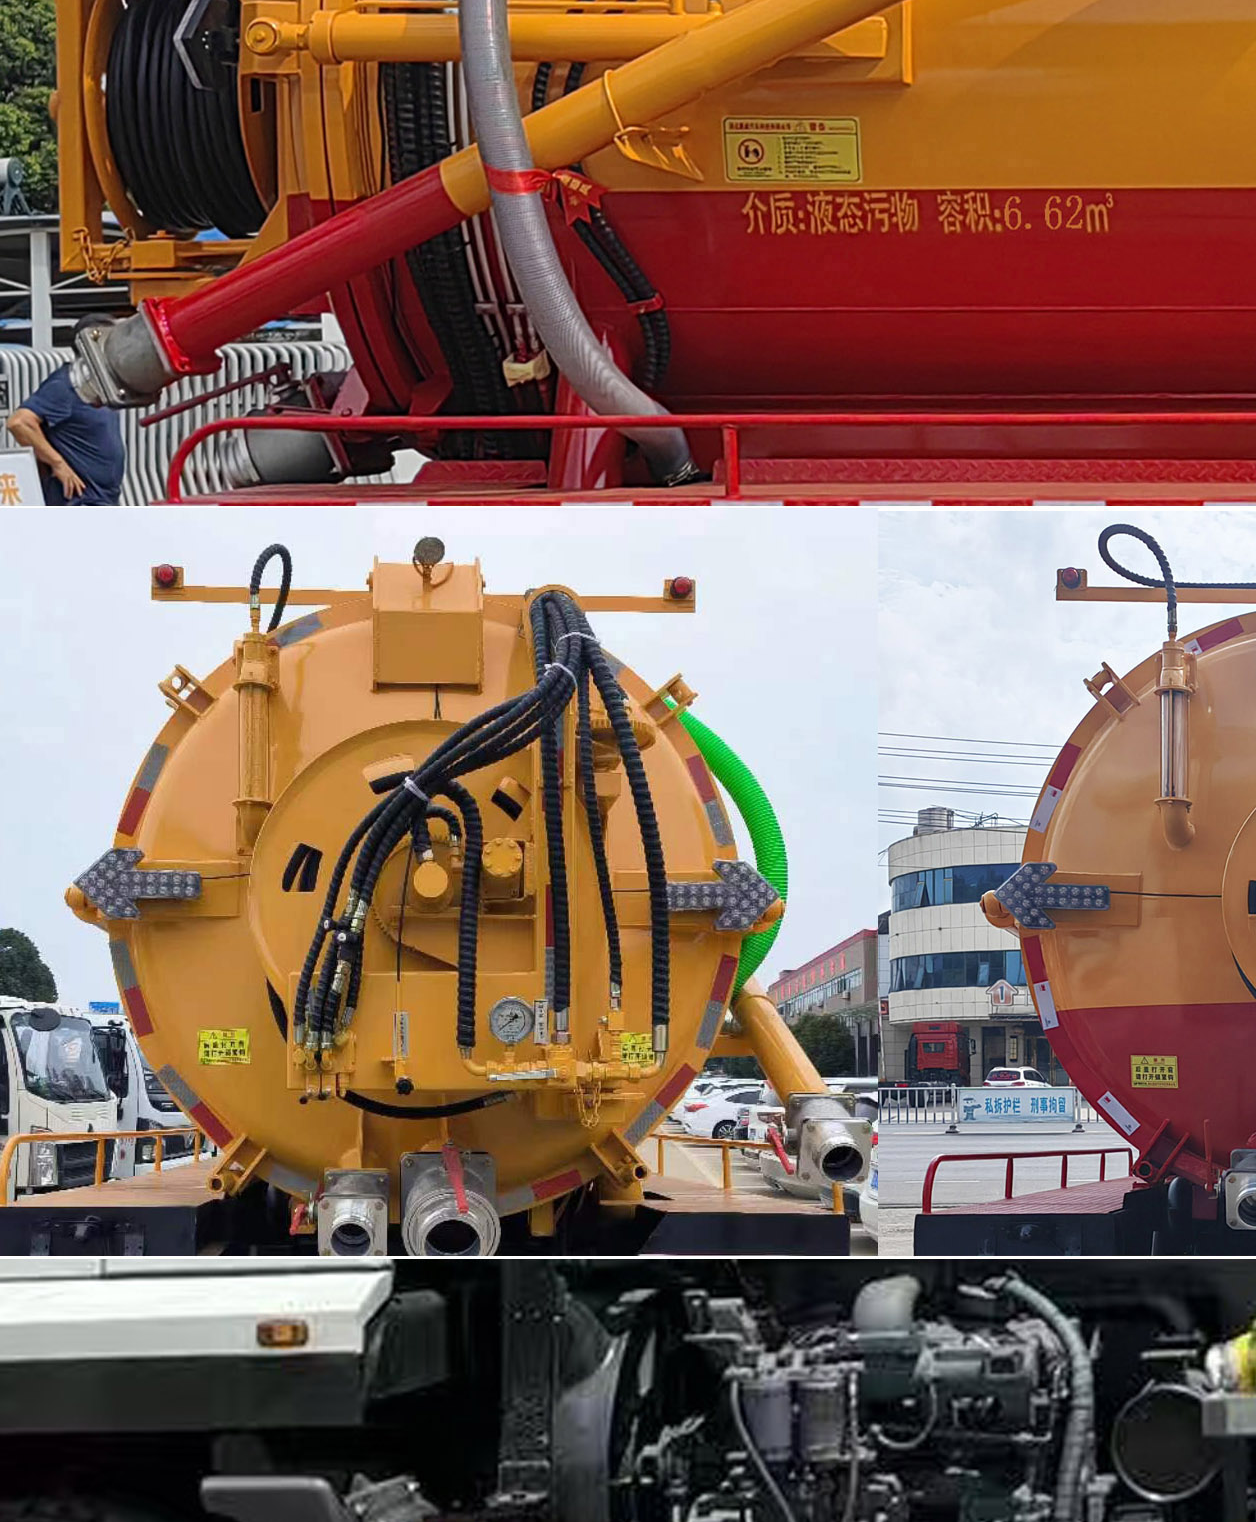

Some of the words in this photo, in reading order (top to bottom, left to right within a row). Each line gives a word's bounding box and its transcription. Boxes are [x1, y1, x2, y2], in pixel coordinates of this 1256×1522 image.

[741, 191, 919, 235] 介质:液态污物
[985, 1096, 1021, 1114] 私拆护栏
[1030, 1096, 1066, 1114] 刑事拘留
